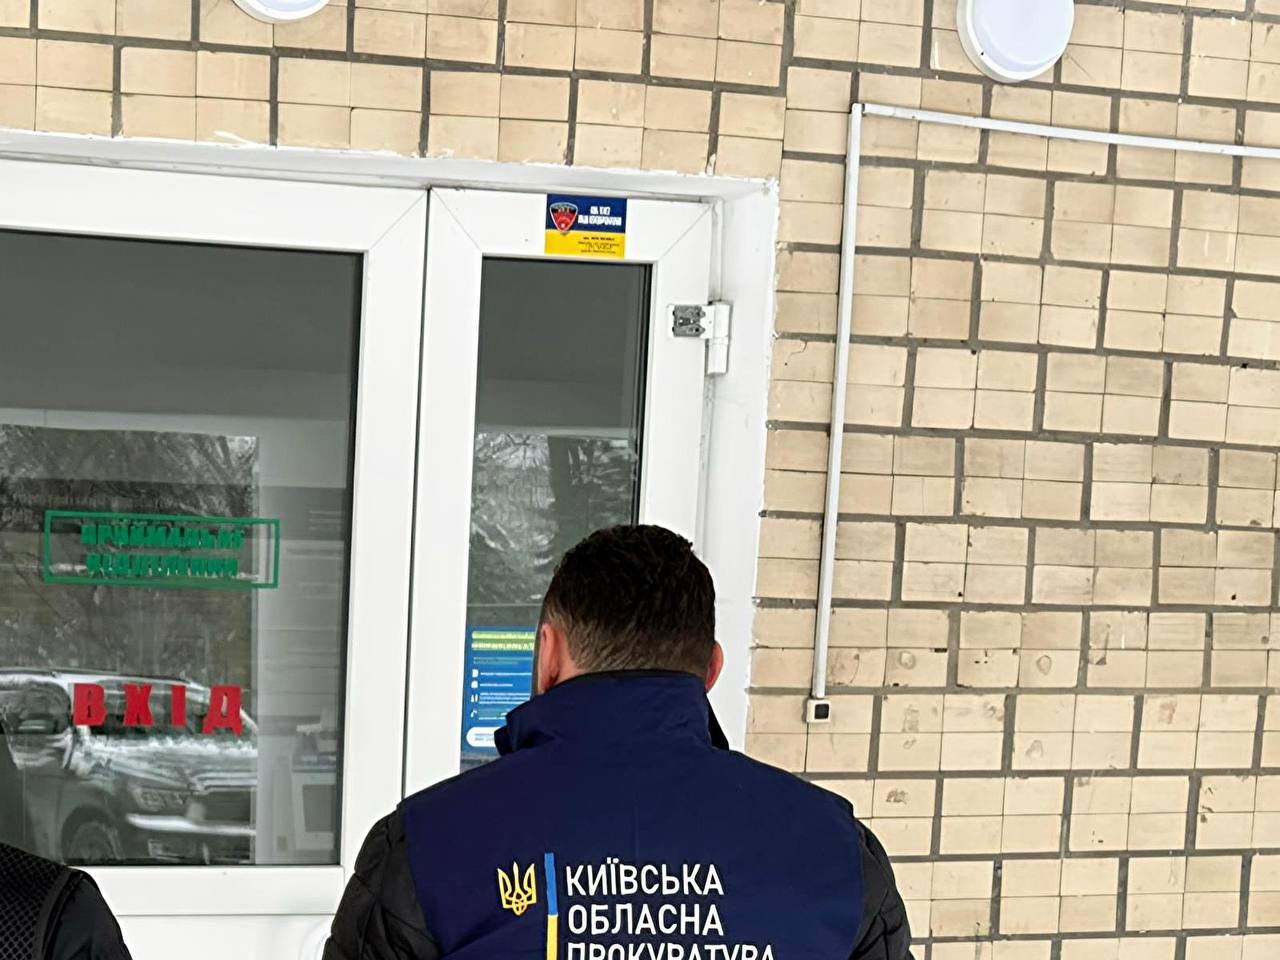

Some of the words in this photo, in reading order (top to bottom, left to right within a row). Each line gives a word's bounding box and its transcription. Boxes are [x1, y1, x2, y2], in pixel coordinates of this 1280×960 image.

[73, 682, 243, 736] ВХІД
[566, 856, 725, 896] КИЇВСЬКА
[568, 903, 725, 936] ОБЛАСНА
